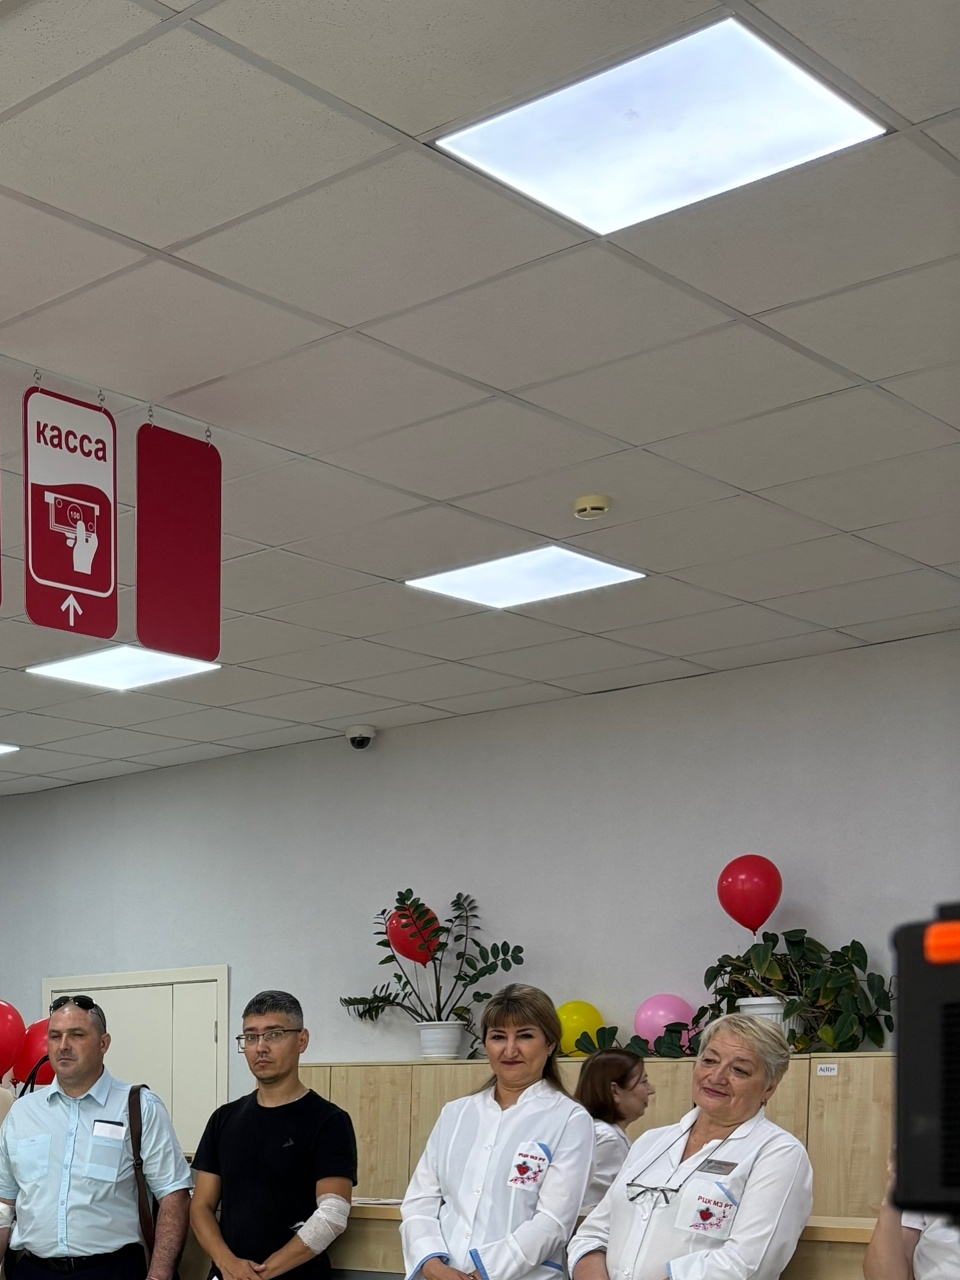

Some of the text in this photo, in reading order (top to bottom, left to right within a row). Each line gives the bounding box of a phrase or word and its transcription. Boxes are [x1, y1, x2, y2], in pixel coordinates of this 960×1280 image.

[36, 420, 107, 462] касса
[697, 1196, 712, 1205] РЦК
[713, 1200, 723, 1208] МЗ
